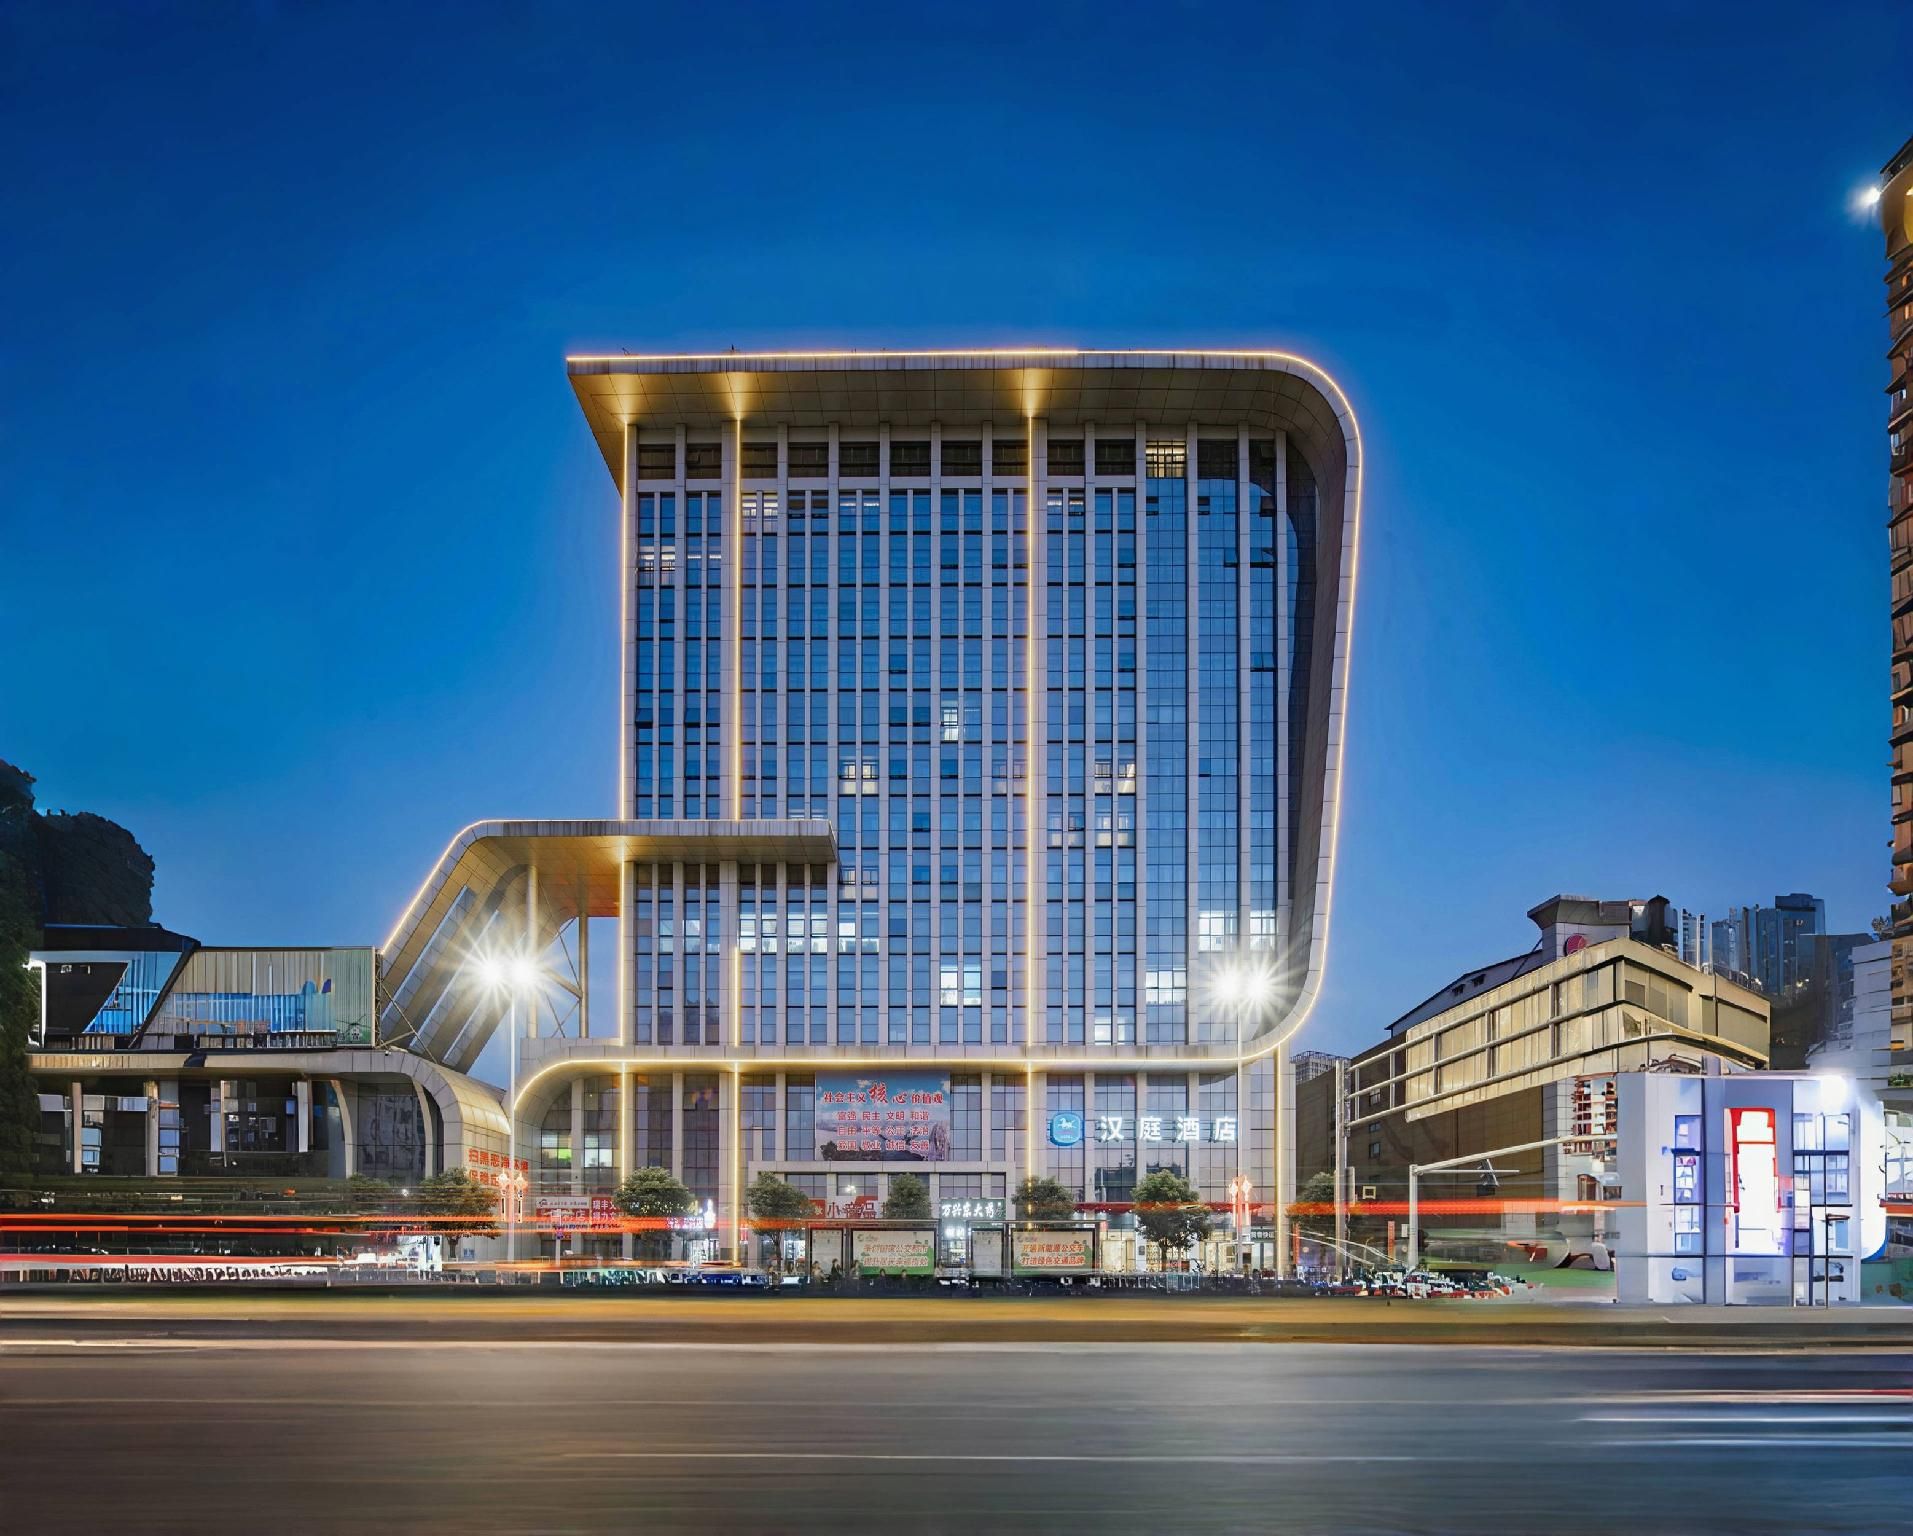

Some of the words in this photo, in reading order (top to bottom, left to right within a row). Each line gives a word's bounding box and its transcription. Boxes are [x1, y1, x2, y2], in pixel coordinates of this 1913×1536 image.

[823, 1082, 943, 1104] 社会主义核心价值观
[862, 1111, 881, 1121] 民主
[886, 1111, 905, 1121] 文明
[911, 1111, 929, 1121] 和谐
[1100, 1115, 1237, 1142] 汉庭酒店
